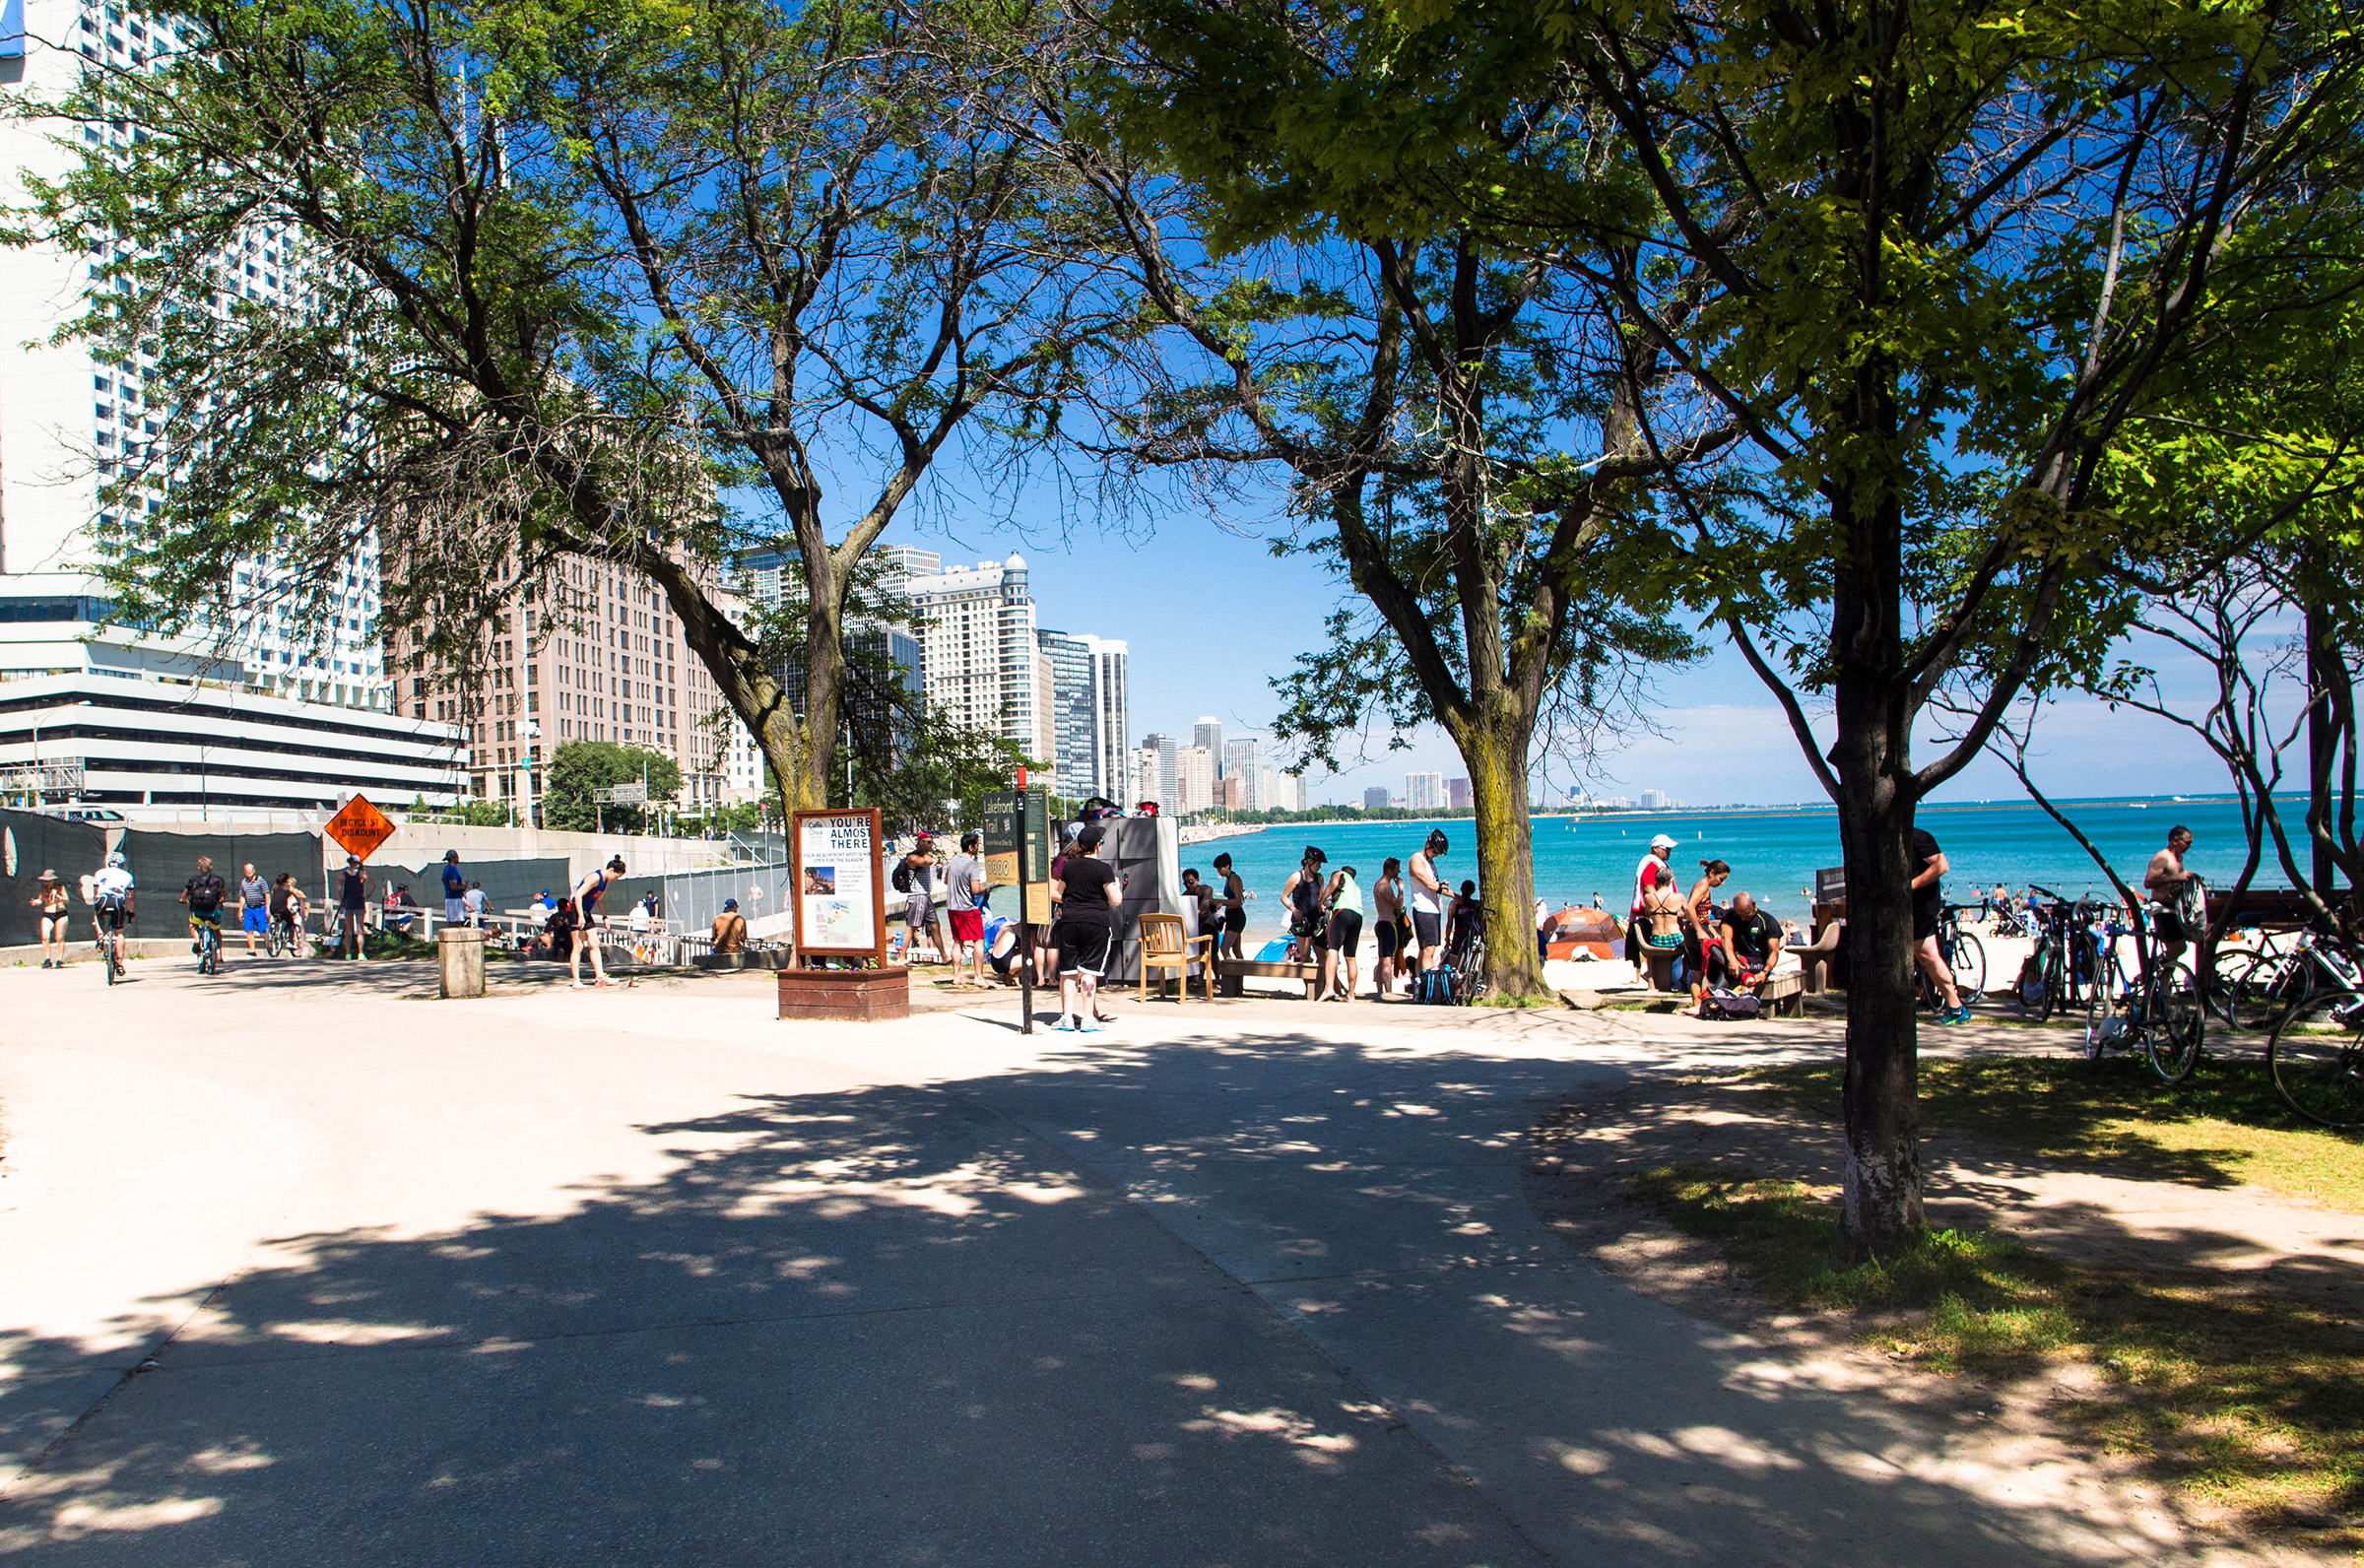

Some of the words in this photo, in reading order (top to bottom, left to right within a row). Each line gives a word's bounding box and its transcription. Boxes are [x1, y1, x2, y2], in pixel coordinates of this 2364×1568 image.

[984, 798, 1014, 814] Lakefront
[830, 817, 871, 827] YOU'RE
[985, 817, 998, 833] Trail
[831, 828, 871, 838] ALMOST
